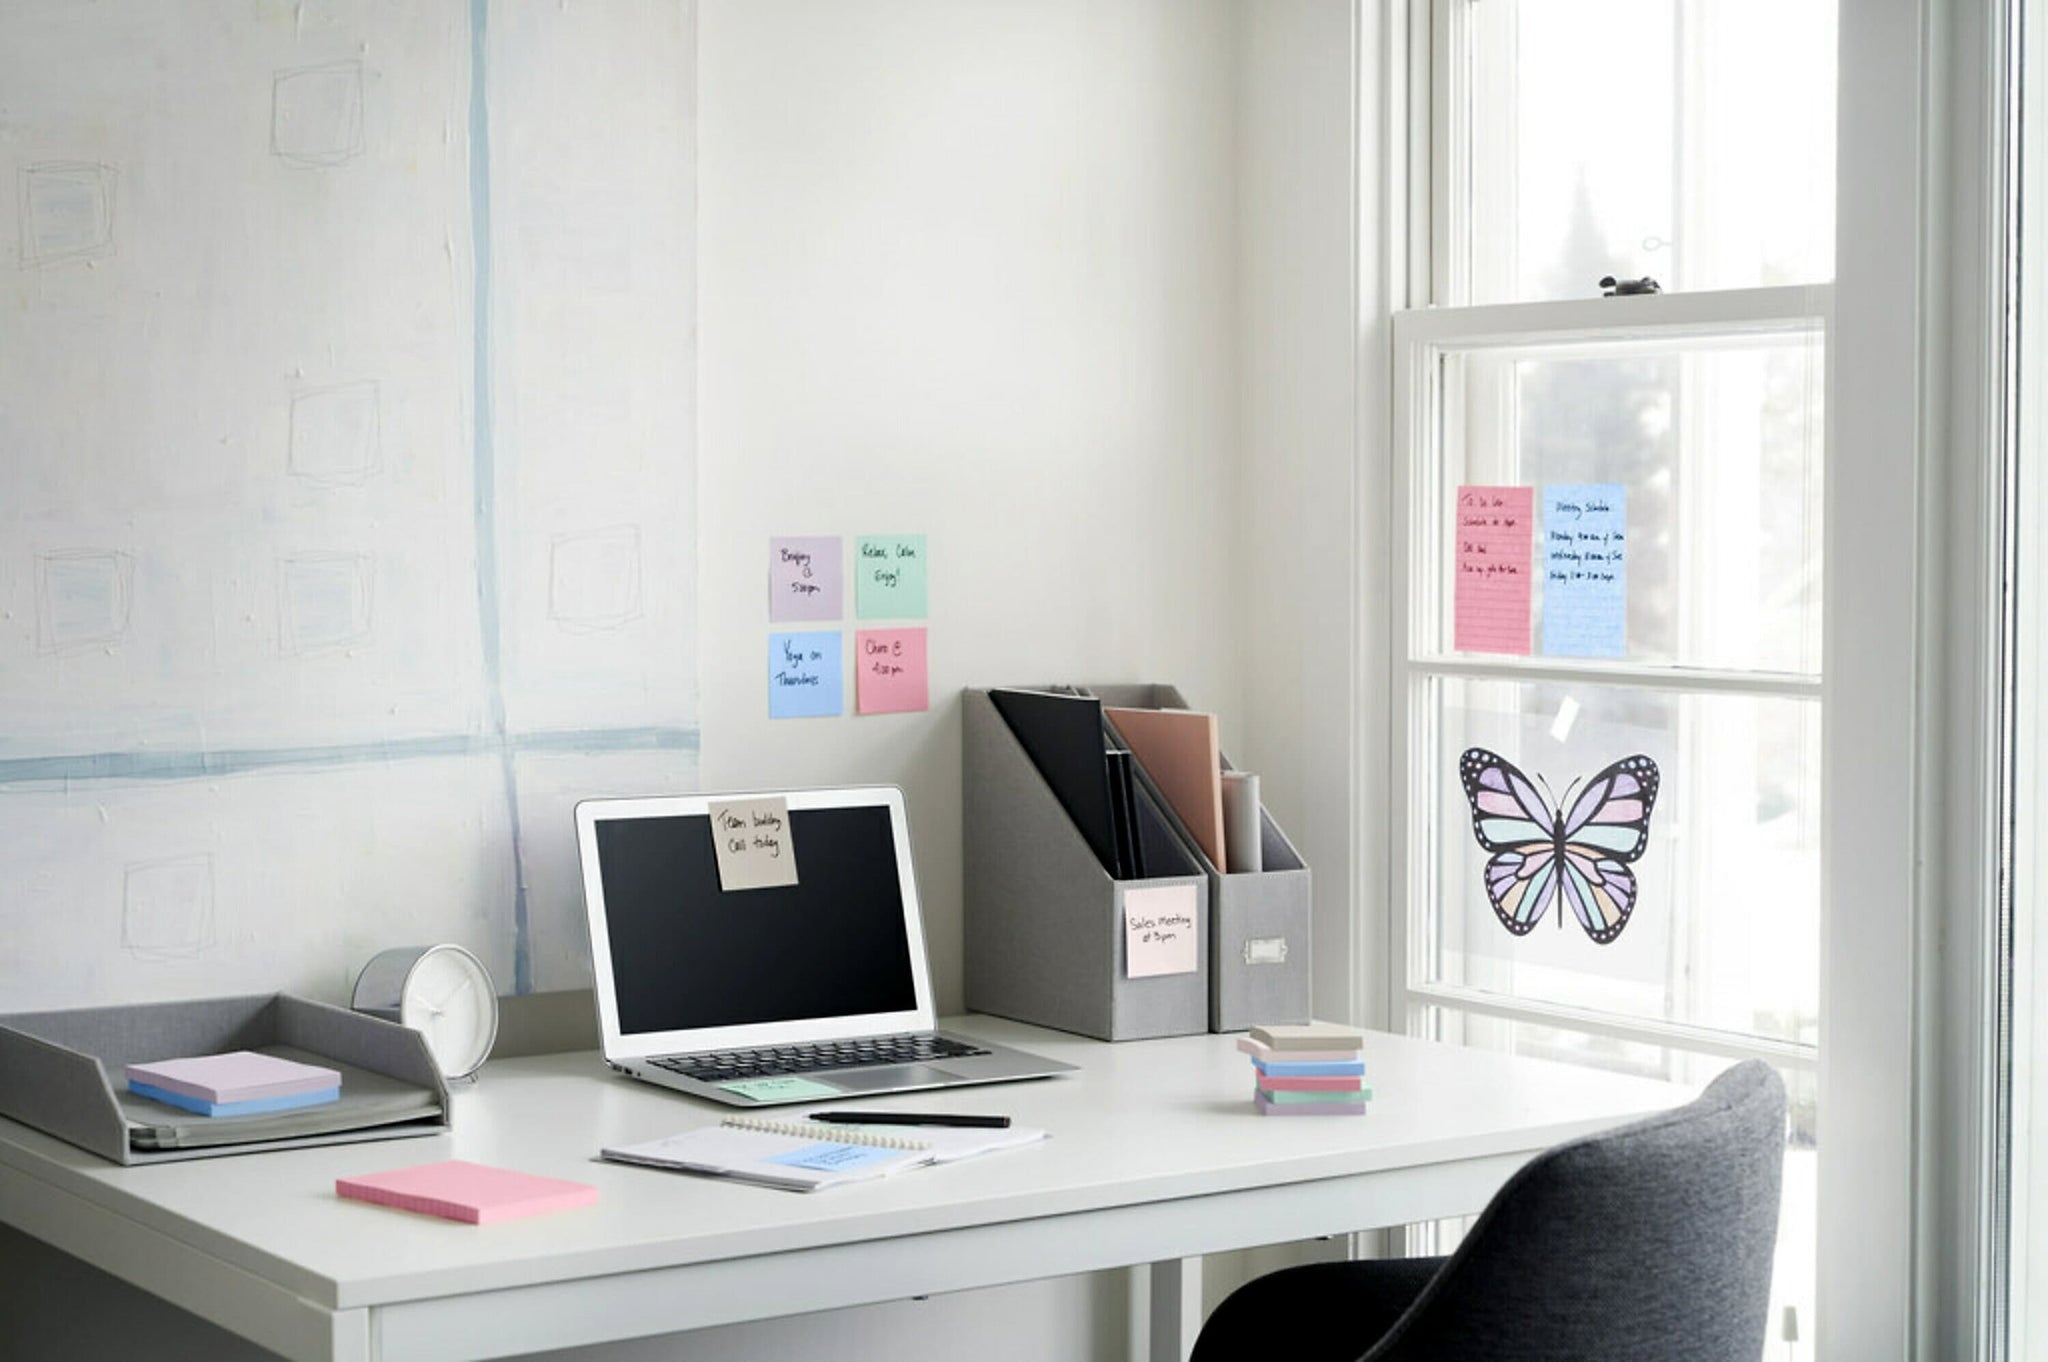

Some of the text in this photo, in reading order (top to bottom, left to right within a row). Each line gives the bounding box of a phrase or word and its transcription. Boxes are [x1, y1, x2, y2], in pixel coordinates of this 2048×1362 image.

[784, 640, 822, 668] Yoga on
[718, 809, 746, 832] Team
[753, 834, 779, 858] today
[1130, 917, 1156, 931] Sales
